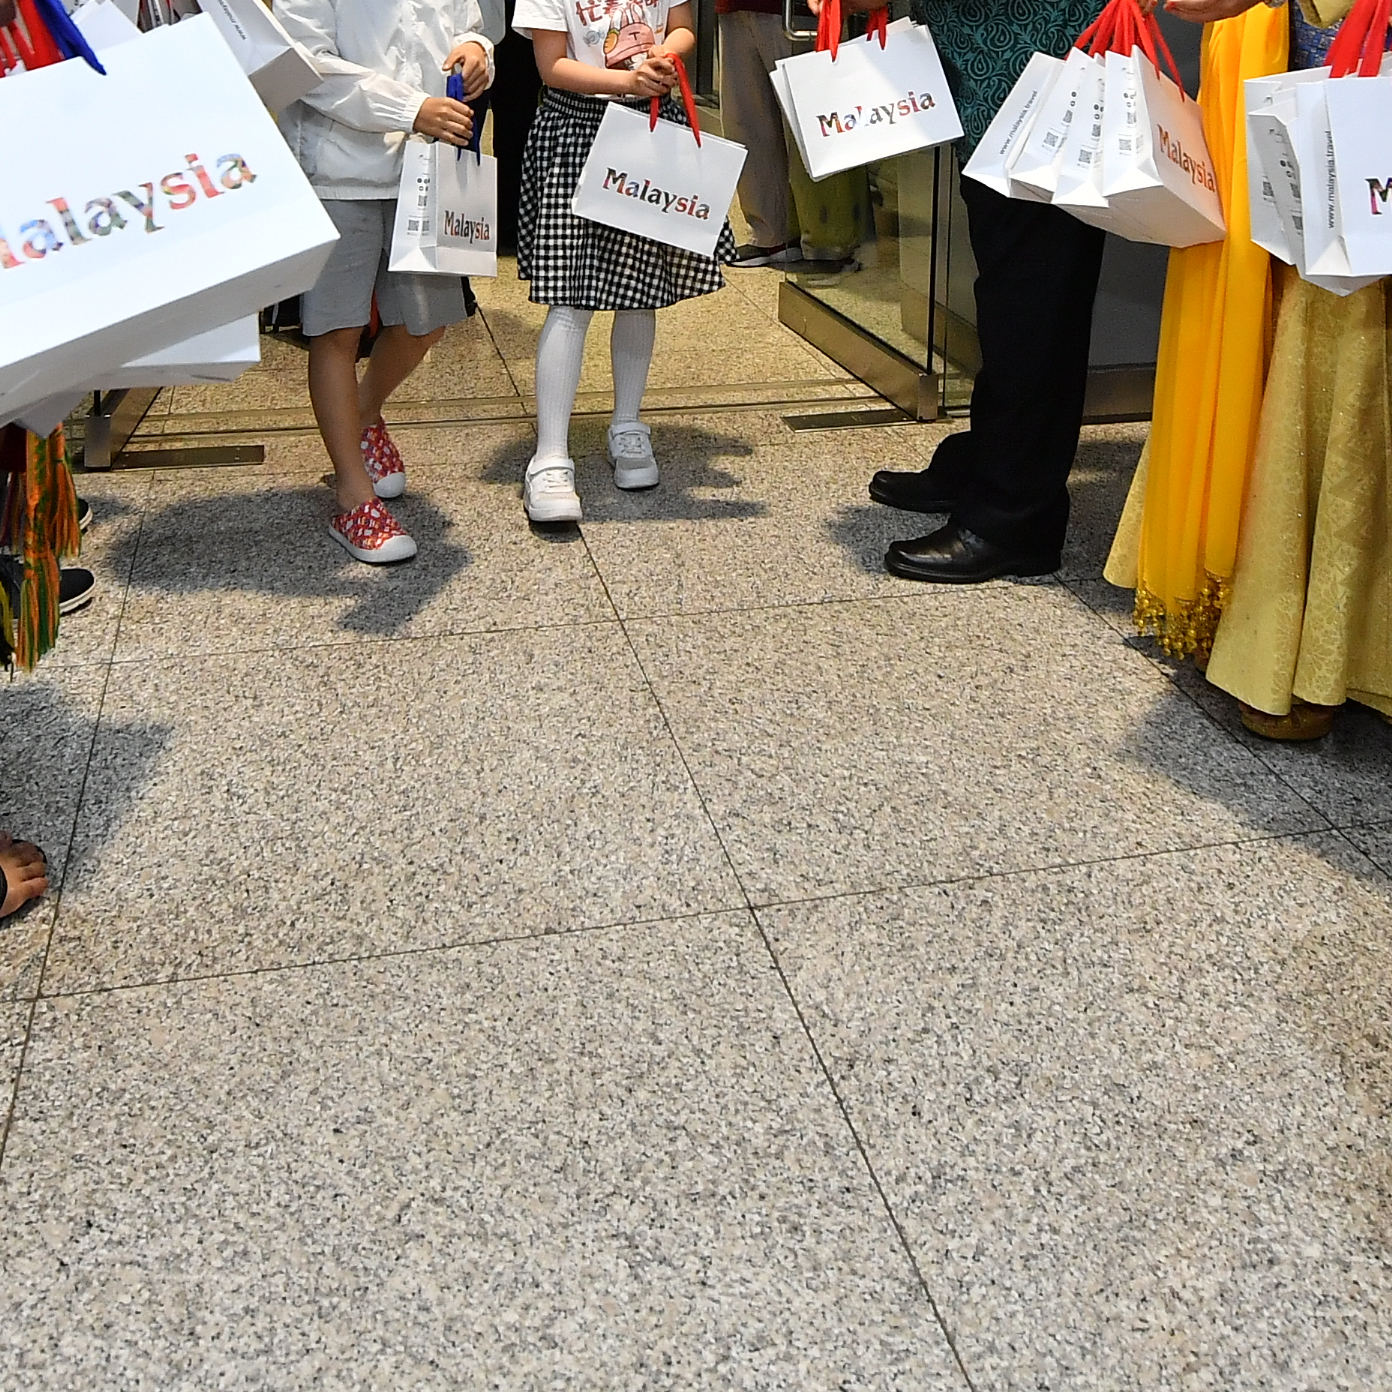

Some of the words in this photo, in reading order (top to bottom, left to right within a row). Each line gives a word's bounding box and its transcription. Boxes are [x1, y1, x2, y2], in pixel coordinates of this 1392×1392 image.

[999, 90, 1038, 155] www.malaysia.travel
[1156, 123, 1216, 193] Malaysia
[1324, 130, 1338, 229] www.malaysia.travel
[602, 167, 711, 220] Malaysia
[444, 210, 490, 244] Malaysia
